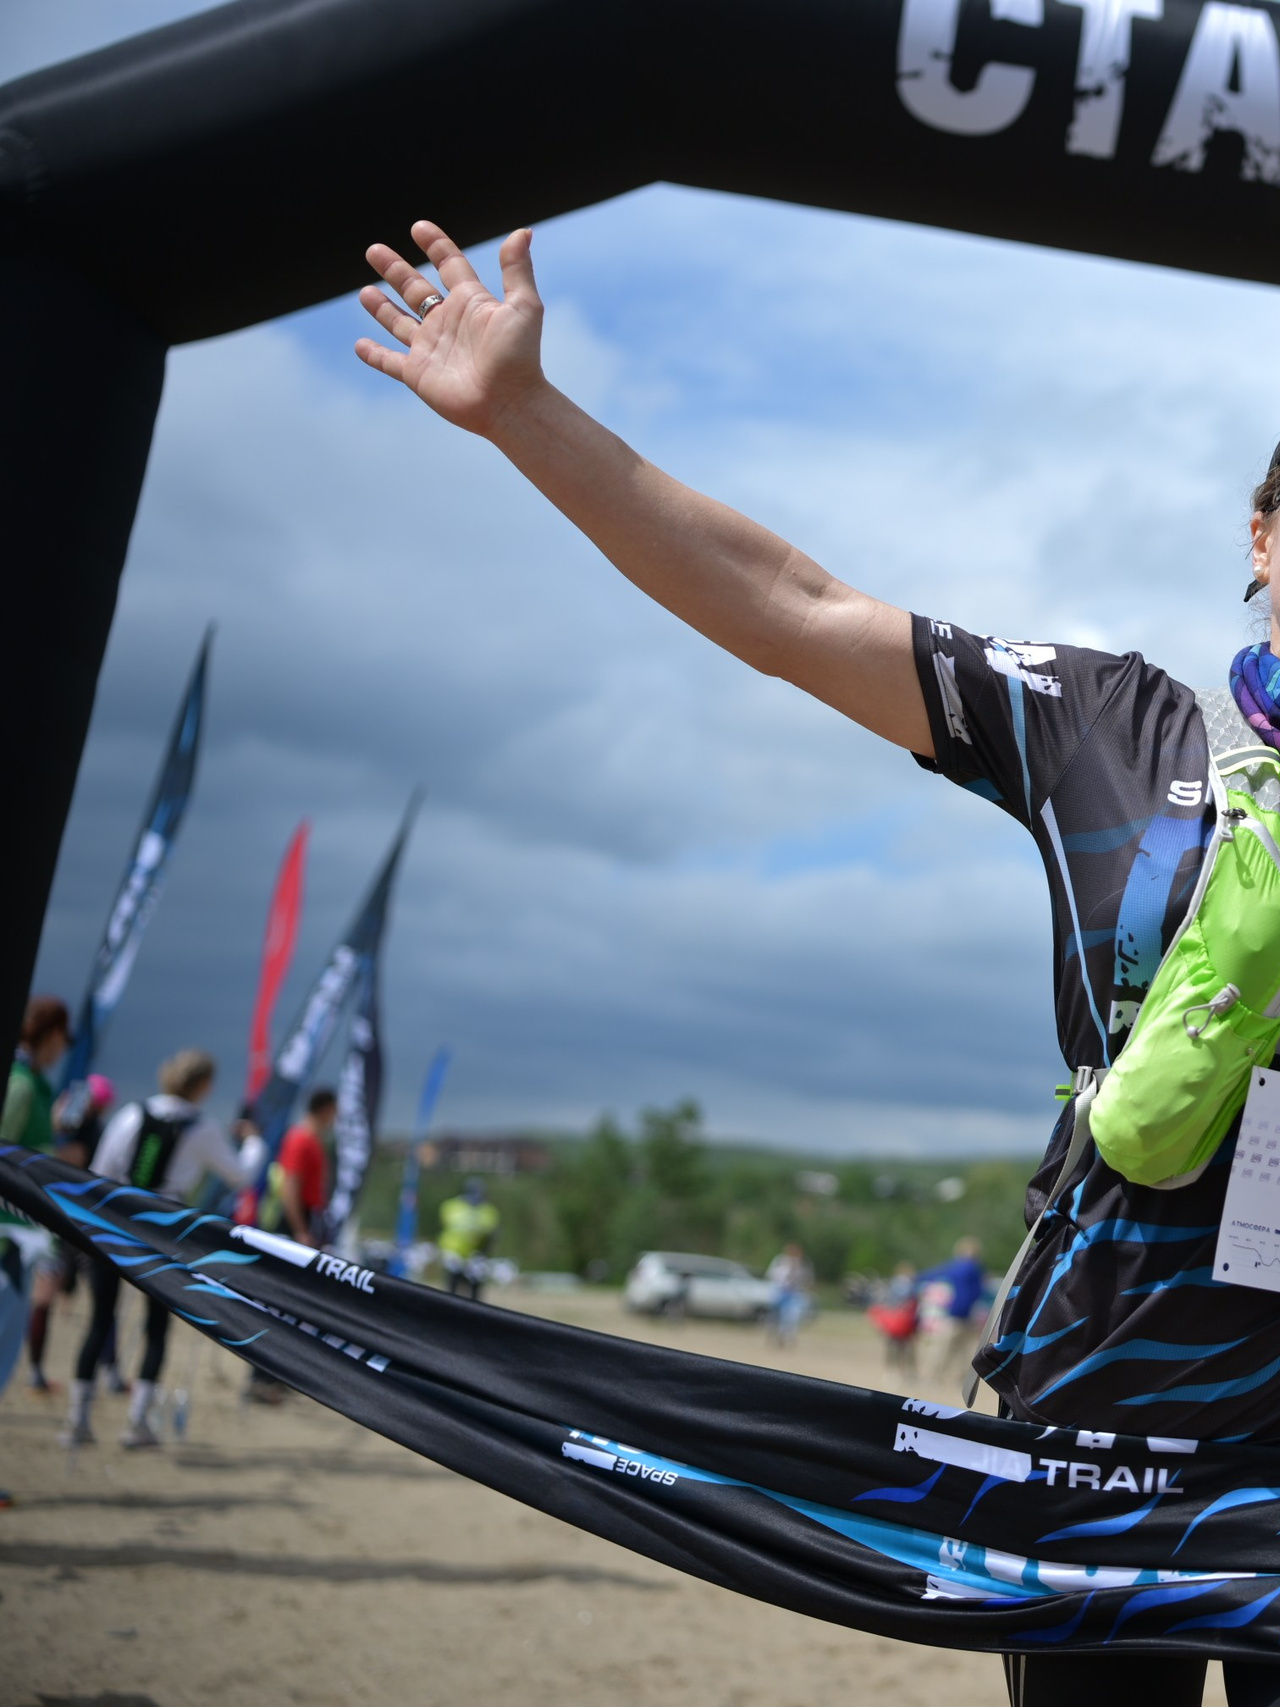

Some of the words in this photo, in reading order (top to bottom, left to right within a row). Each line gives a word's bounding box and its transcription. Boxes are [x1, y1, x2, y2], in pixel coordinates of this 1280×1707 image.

[1231, 1220, 1271, 1233] АТМОСФЕРА
[316, 1252, 376, 1295] TRAIL
[615, 1457, 679, 1486] SPACE
[1039, 1458, 1185, 1495] TRAIL
